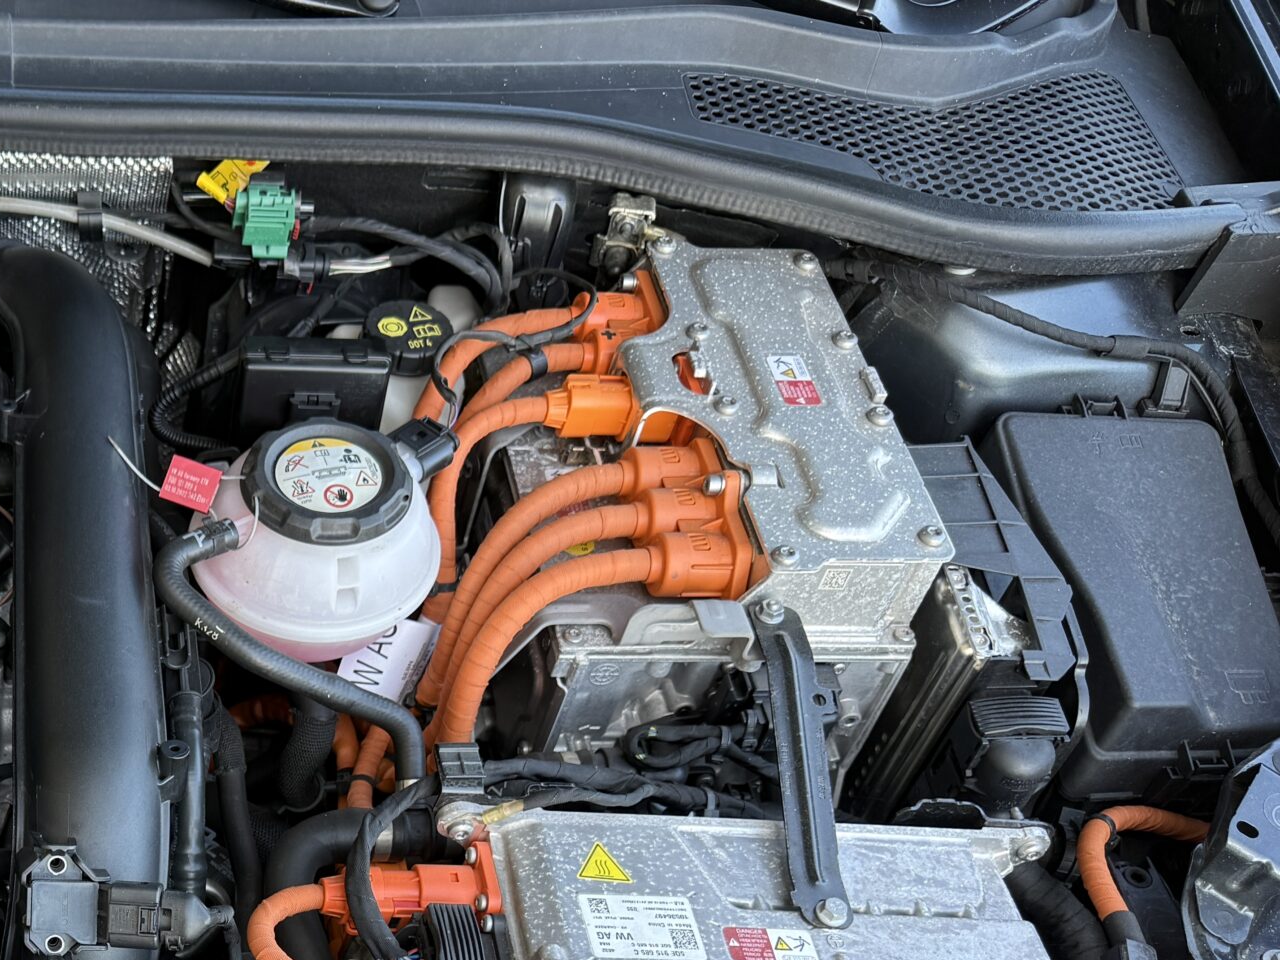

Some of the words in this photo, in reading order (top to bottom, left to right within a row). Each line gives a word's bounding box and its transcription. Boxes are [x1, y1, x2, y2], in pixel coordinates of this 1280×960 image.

[408, 340, 424, 349] DOT
[426, 339, 432, 347] 4
[596, 931, 611, 940] AG
[615, 932, 634, 941] VW
